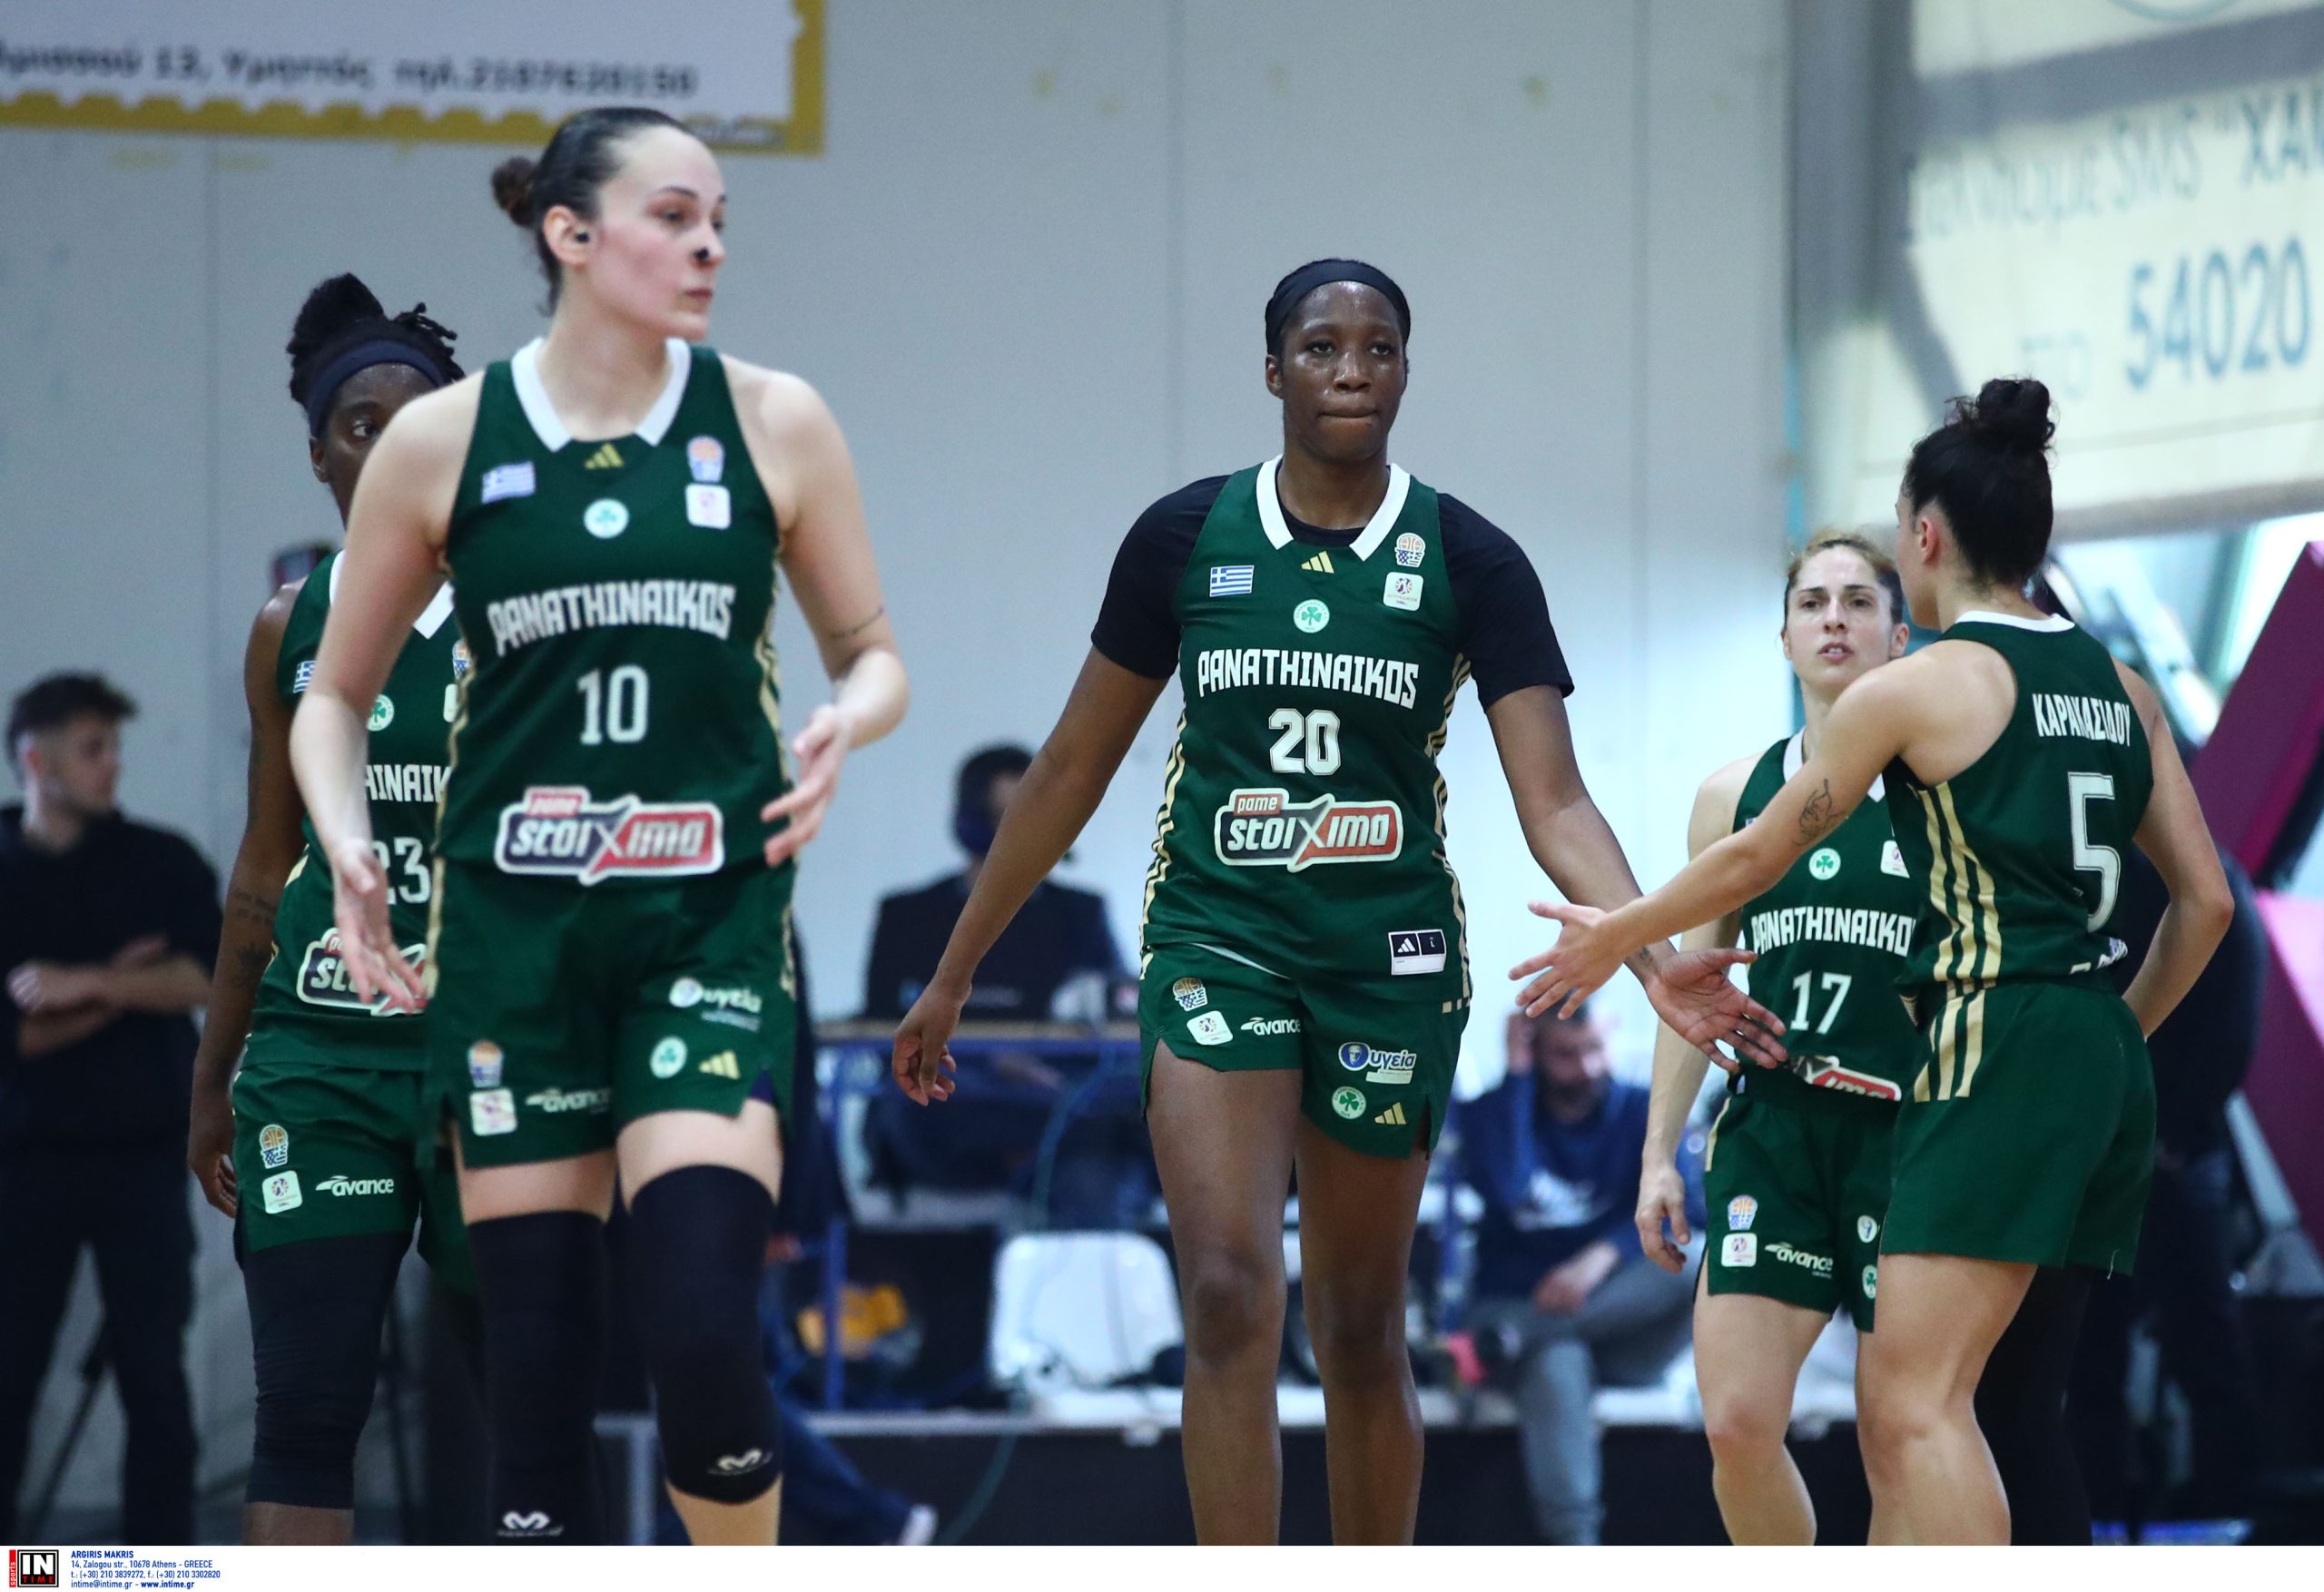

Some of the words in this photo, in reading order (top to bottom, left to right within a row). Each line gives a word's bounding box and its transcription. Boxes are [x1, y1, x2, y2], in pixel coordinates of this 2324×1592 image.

[2125, 237, 2311, 392] 54020
[487, 579, 736, 657] PANATHINAIKOS
[577, 663, 648, 745] 10
[1198, 648, 1419, 710] PANATHINAIKOS
[1269, 708, 1341, 776] 20
[1236, 797, 1278, 814] pame
[2068, 771, 2121, 933] 5
[1750, 906, 1916, 958] PANATHINAIKO
[1253, 1018, 1301, 1036] avance
[1790, 969, 1852, 1035] 17
[331, 1178, 394, 1196] avance
[1777, 1248, 1833, 1272] avance
